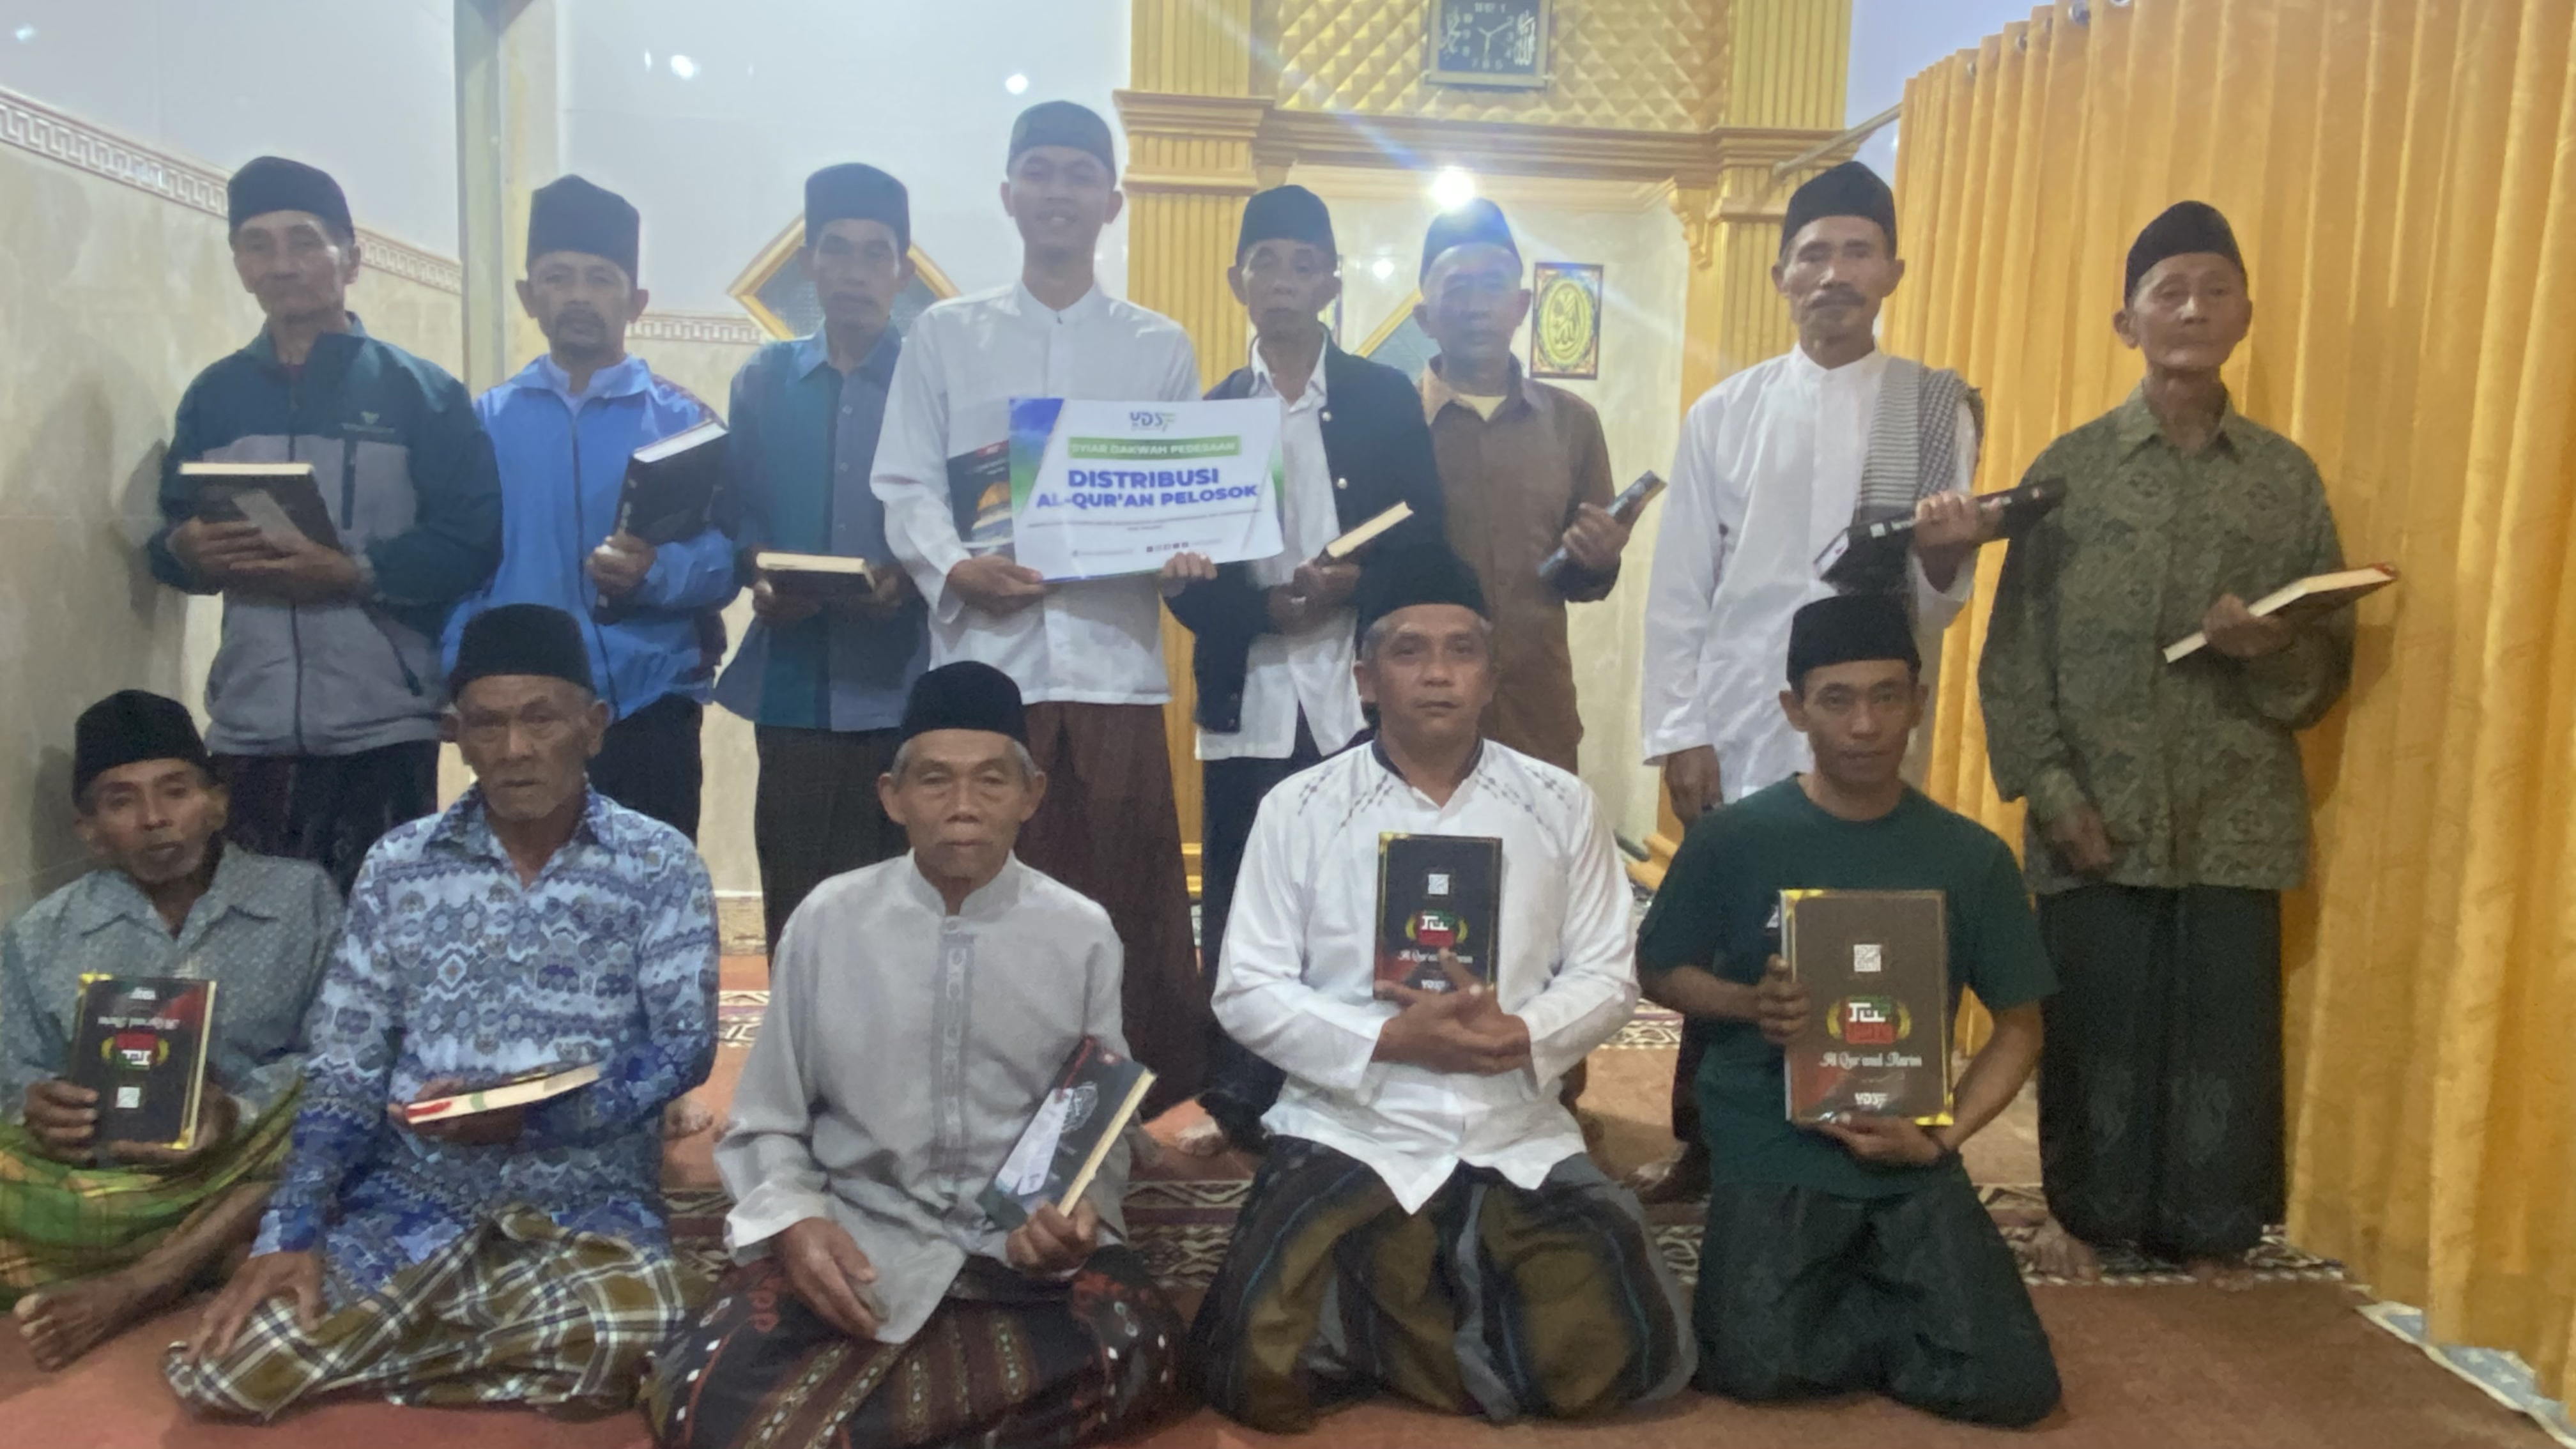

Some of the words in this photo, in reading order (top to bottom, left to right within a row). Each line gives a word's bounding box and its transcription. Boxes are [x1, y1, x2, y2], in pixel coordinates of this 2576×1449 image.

[1110, 445, 1167, 454] DAKWAH
[1068, 468, 1219, 488] DISTRIBUSI
[1036, 493, 1154, 509] AL-QUR'AN
[1161, 485, 1257, 506] PELOSOK
